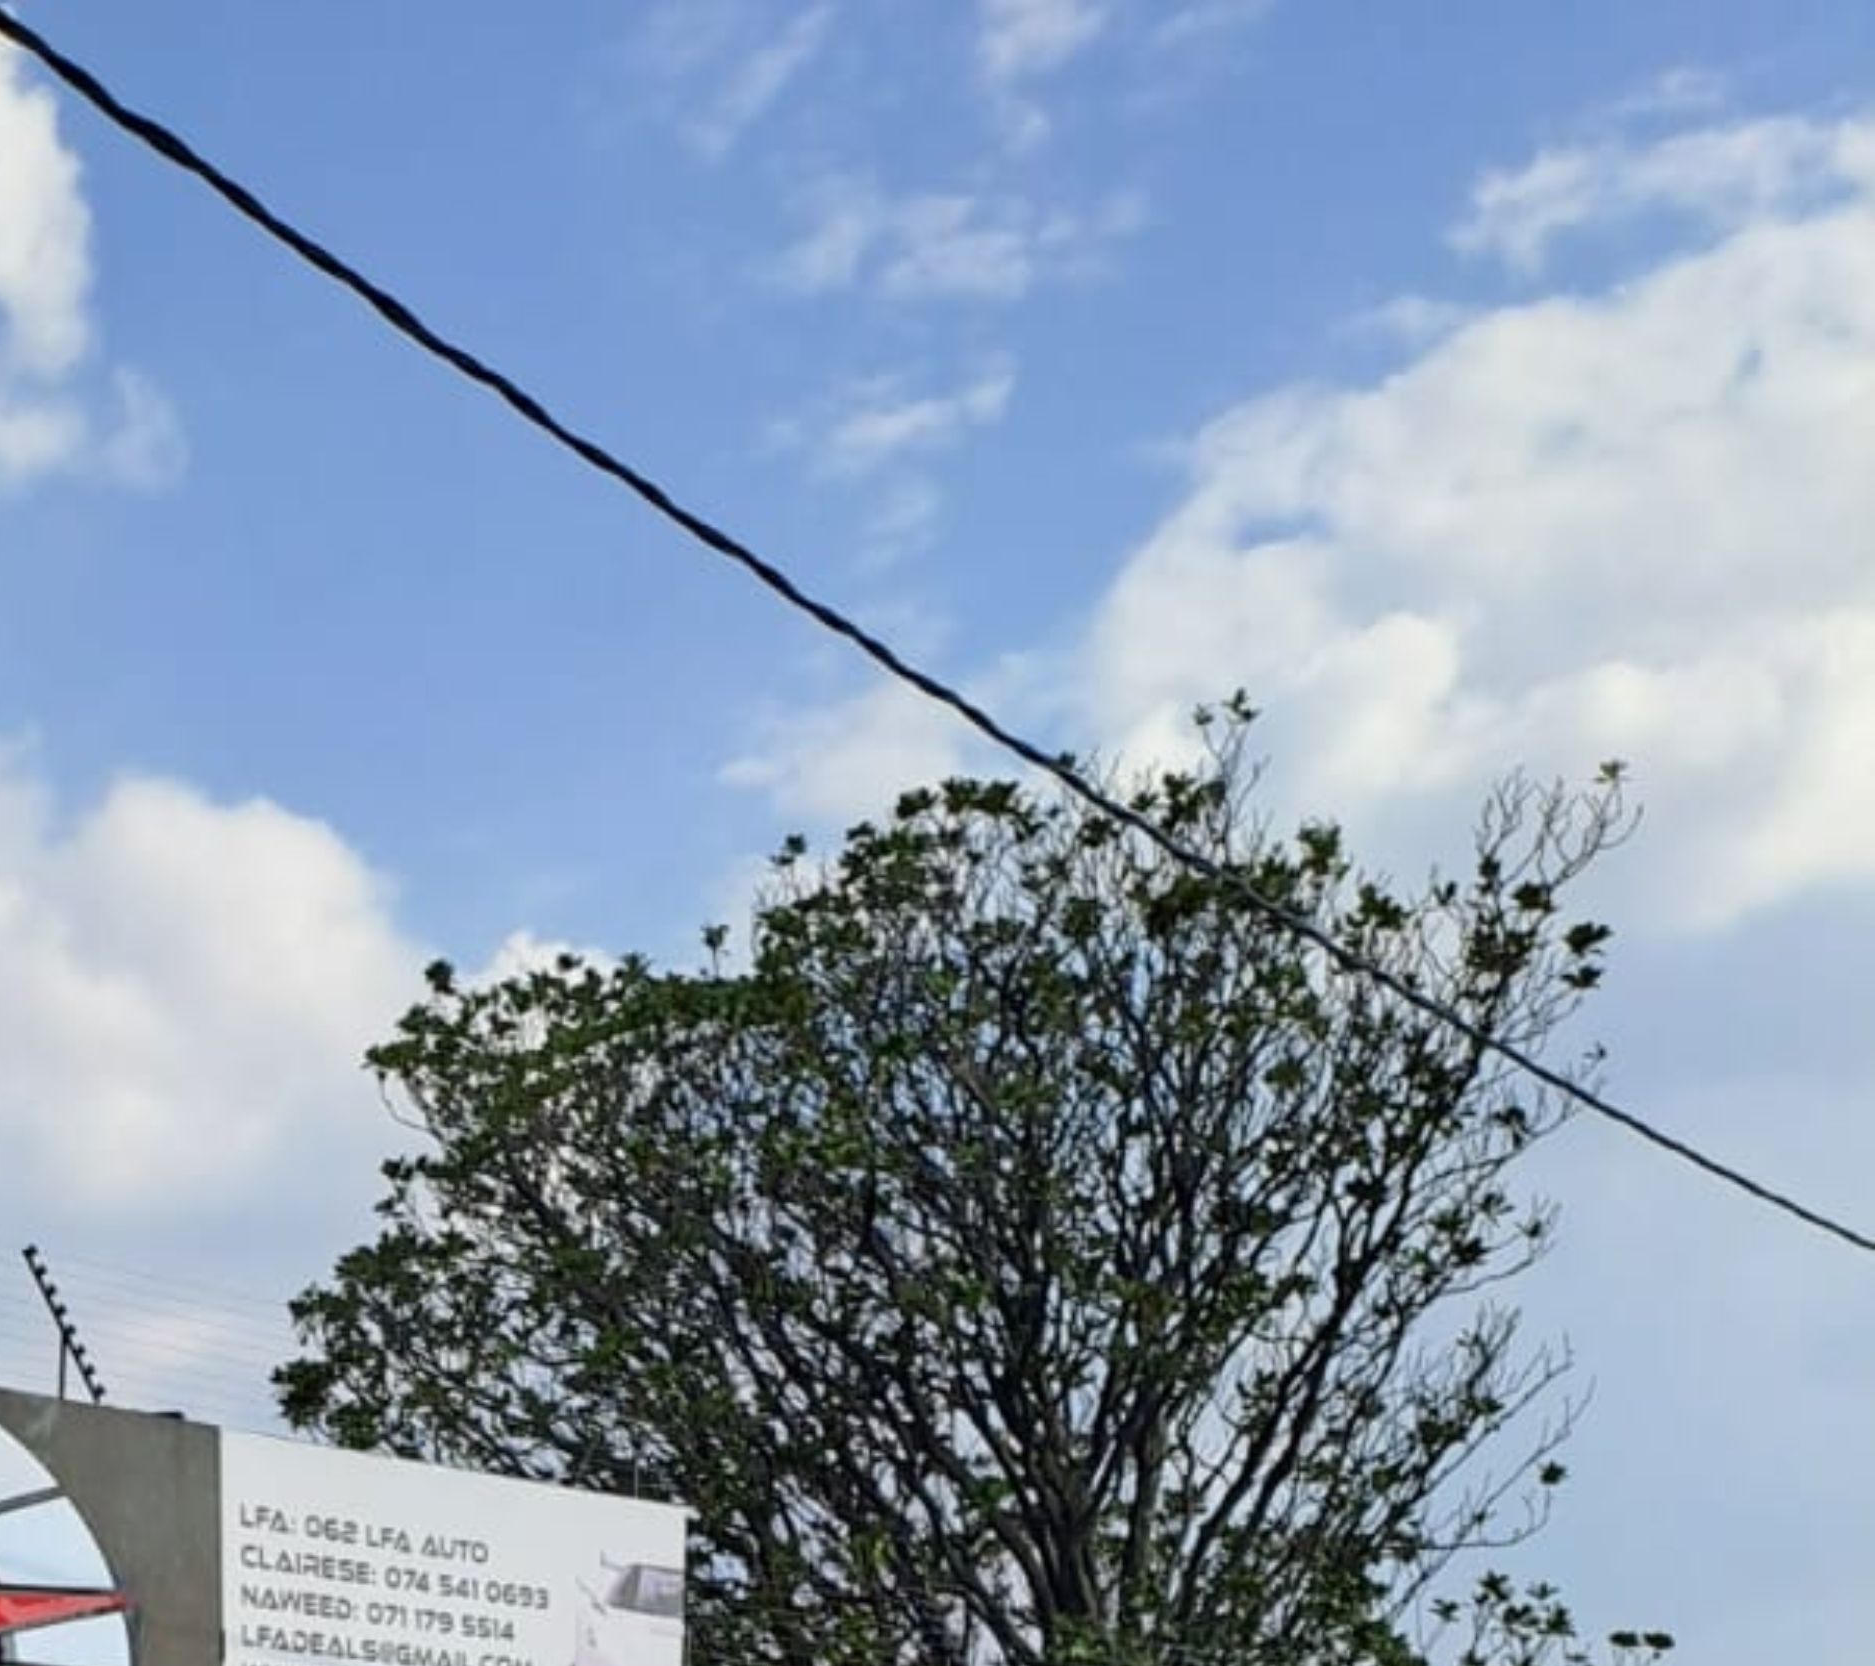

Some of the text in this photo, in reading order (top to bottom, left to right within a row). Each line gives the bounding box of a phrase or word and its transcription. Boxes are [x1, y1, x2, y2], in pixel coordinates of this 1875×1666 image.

[239, 1502, 489, 1563] LFA: 062 LFA AUTO
